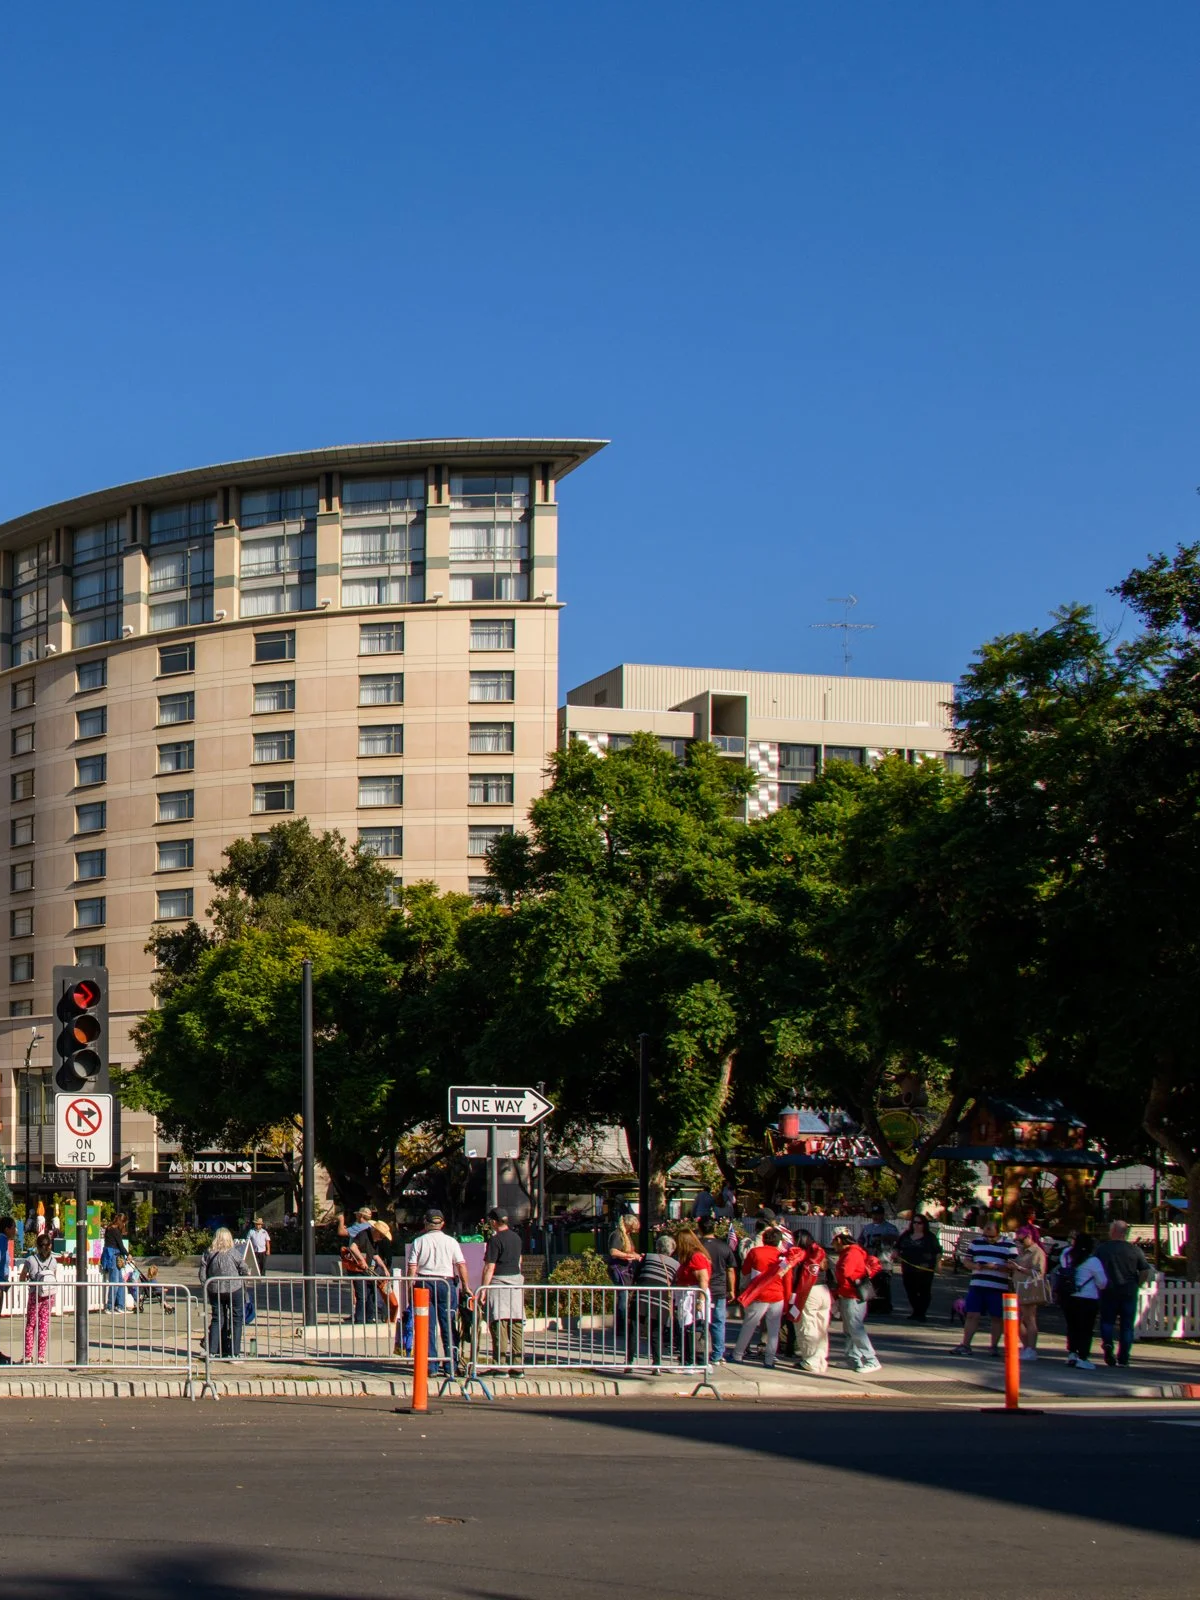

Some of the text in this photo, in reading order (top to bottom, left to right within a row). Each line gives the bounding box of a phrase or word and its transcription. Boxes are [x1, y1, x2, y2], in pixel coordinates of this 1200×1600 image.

[461, 1099, 523, 1113] ONE WAY
[75, 1138, 92, 1149] ON
[72, 1152, 96, 1162] RED
[168, 1160, 252, 1173] MORTON'S
